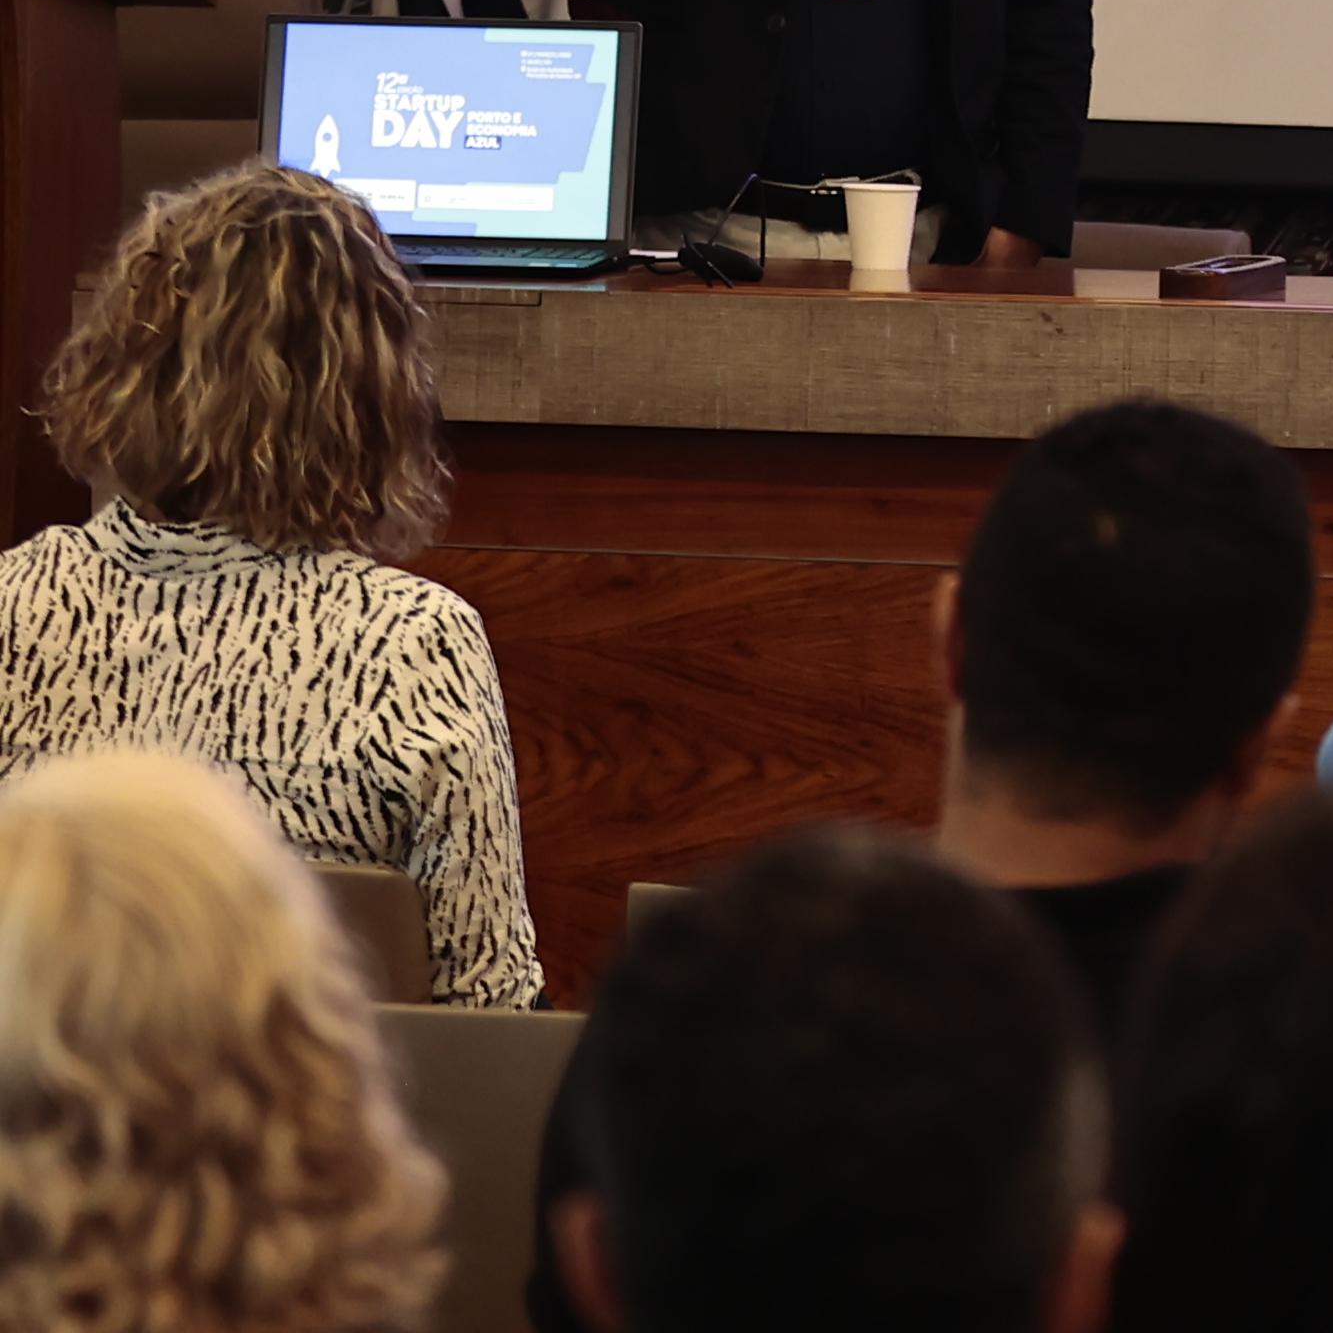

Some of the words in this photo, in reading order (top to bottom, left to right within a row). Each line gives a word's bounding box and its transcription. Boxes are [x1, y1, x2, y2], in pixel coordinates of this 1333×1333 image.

[374, 94, 465, 112] STARTUP
[467, 112, 510, 124] PORTO
[371, 109, 464, 149] DAY
[466, 137, 500, 149] AZUL
